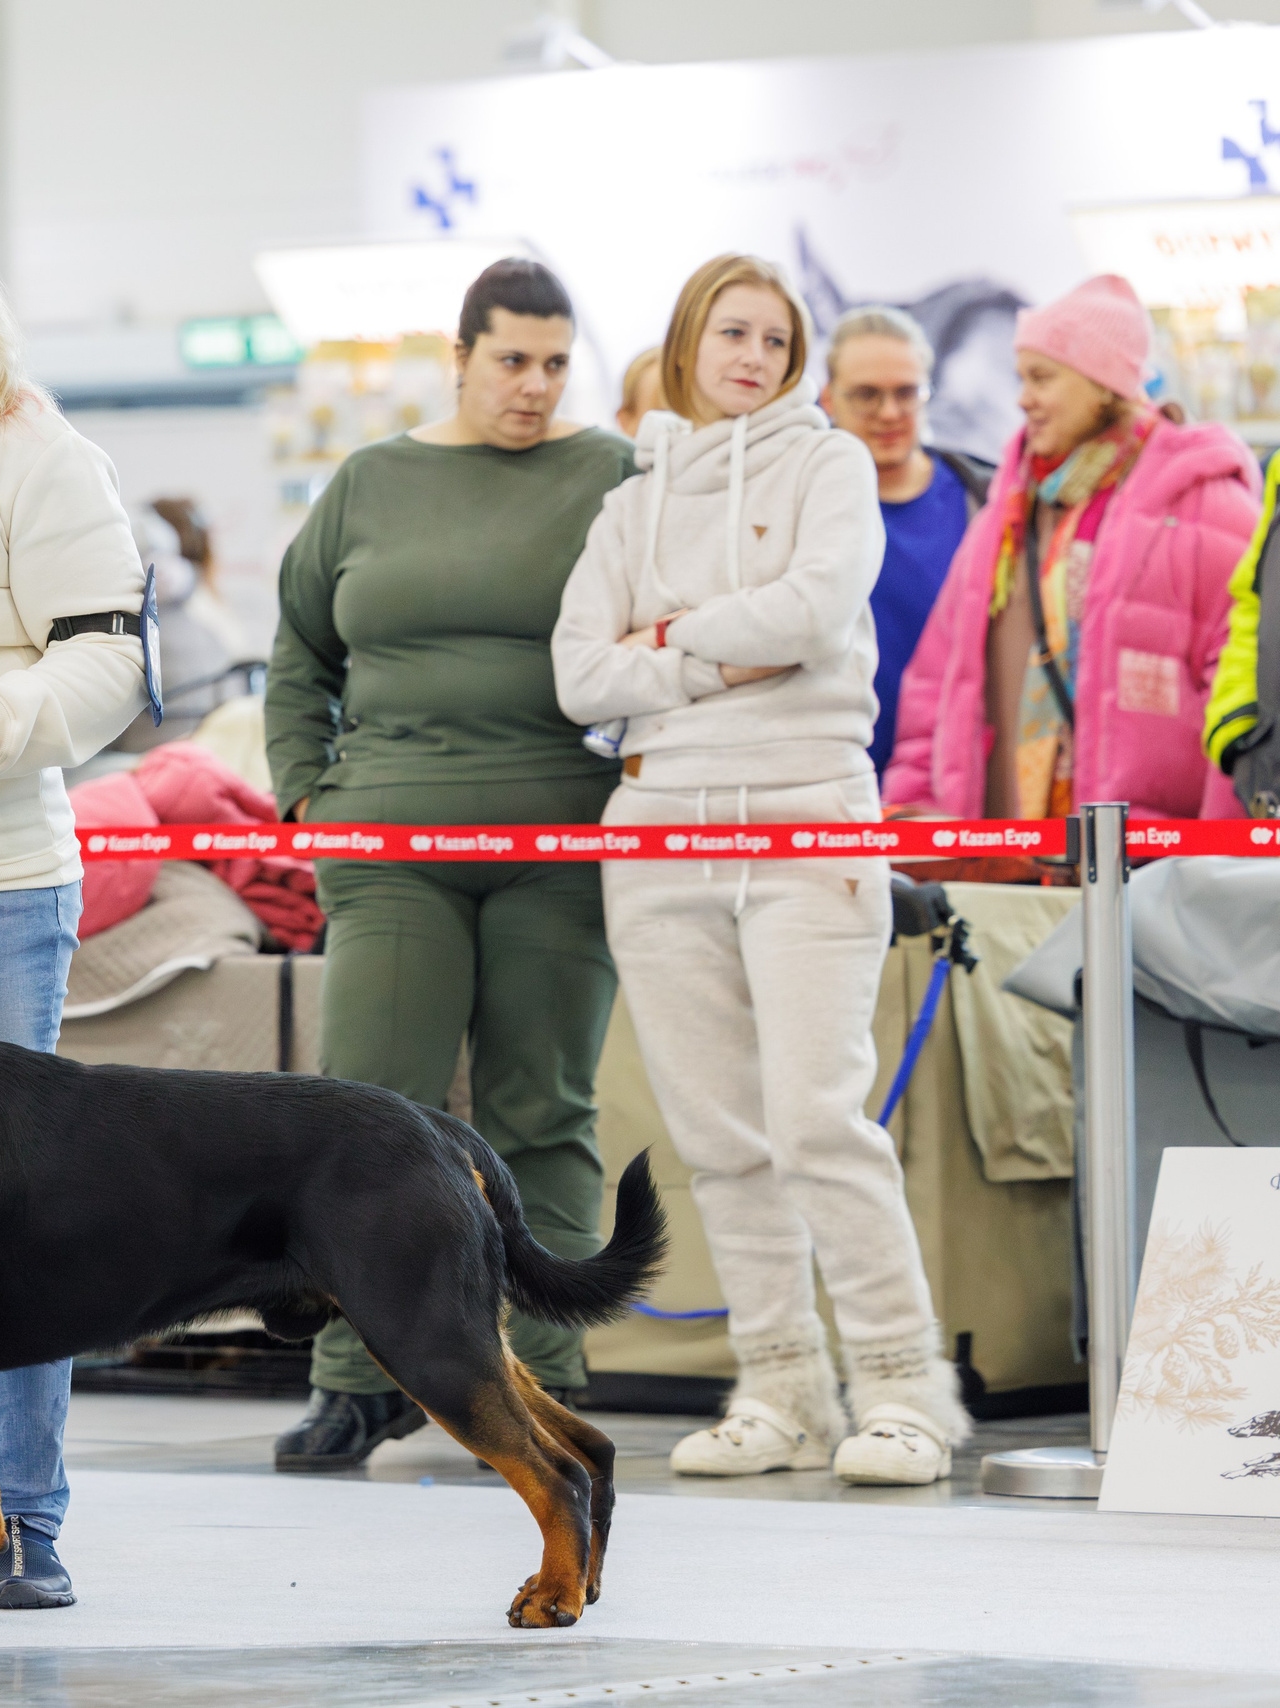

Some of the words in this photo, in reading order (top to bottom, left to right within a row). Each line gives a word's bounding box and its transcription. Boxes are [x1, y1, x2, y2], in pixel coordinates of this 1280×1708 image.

[312, 833, 349, 850] Kazan
[350, 832, 385, 853] Expo
[434, 835, 477, 852] Kazan
[477, 833, 514, 854] Expo
[560, 834, 604, 851] Kazan
[604, 832, 641, 854] Expo
[690, 834, 734, 851] Kazan
[734, 833, 771, 853] Expo
[817, 831, 861, 848] Kazan
[862, 830, 899, 851] Expo
[959, 830, 1003, 847] Kazan
[1004, 828, 1041, 849] Expo
[1125, 830, 1145, 845] zan
[1146, 827, 1181, 848] Expo
[10, 1515, 20, 1535] SPOR
